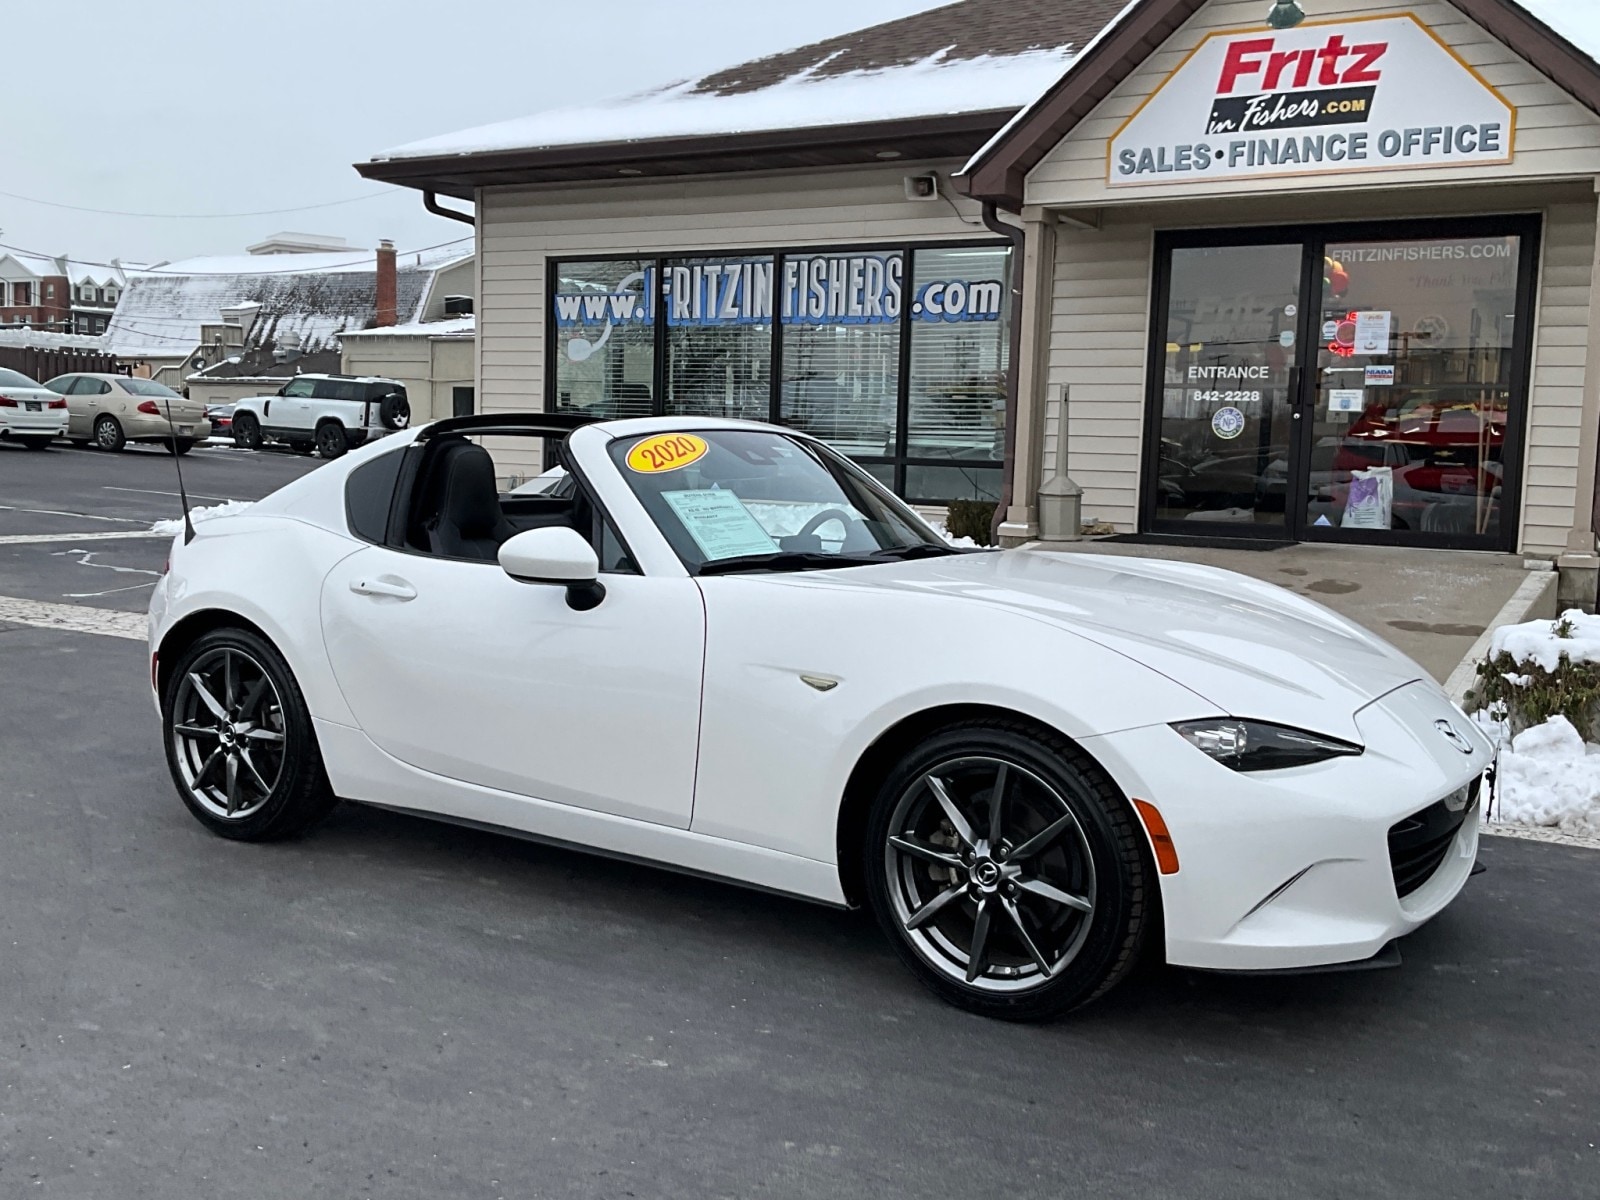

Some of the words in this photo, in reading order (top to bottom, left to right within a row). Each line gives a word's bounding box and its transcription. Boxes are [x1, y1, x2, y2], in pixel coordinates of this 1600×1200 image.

[1216, 35, 1388, 94] Fritz
[1208, 112, 1236, 134] in
[1377, 123, 1501, 158] OFFICE
[1332, 244, 1511, 263] FRITZINFISHERS.COM
[1188, 366, 1270, 379] ENTRANCE
[1193, 390, 1260, 402] 842-2228
[641, 437, 696, 469] 2020
